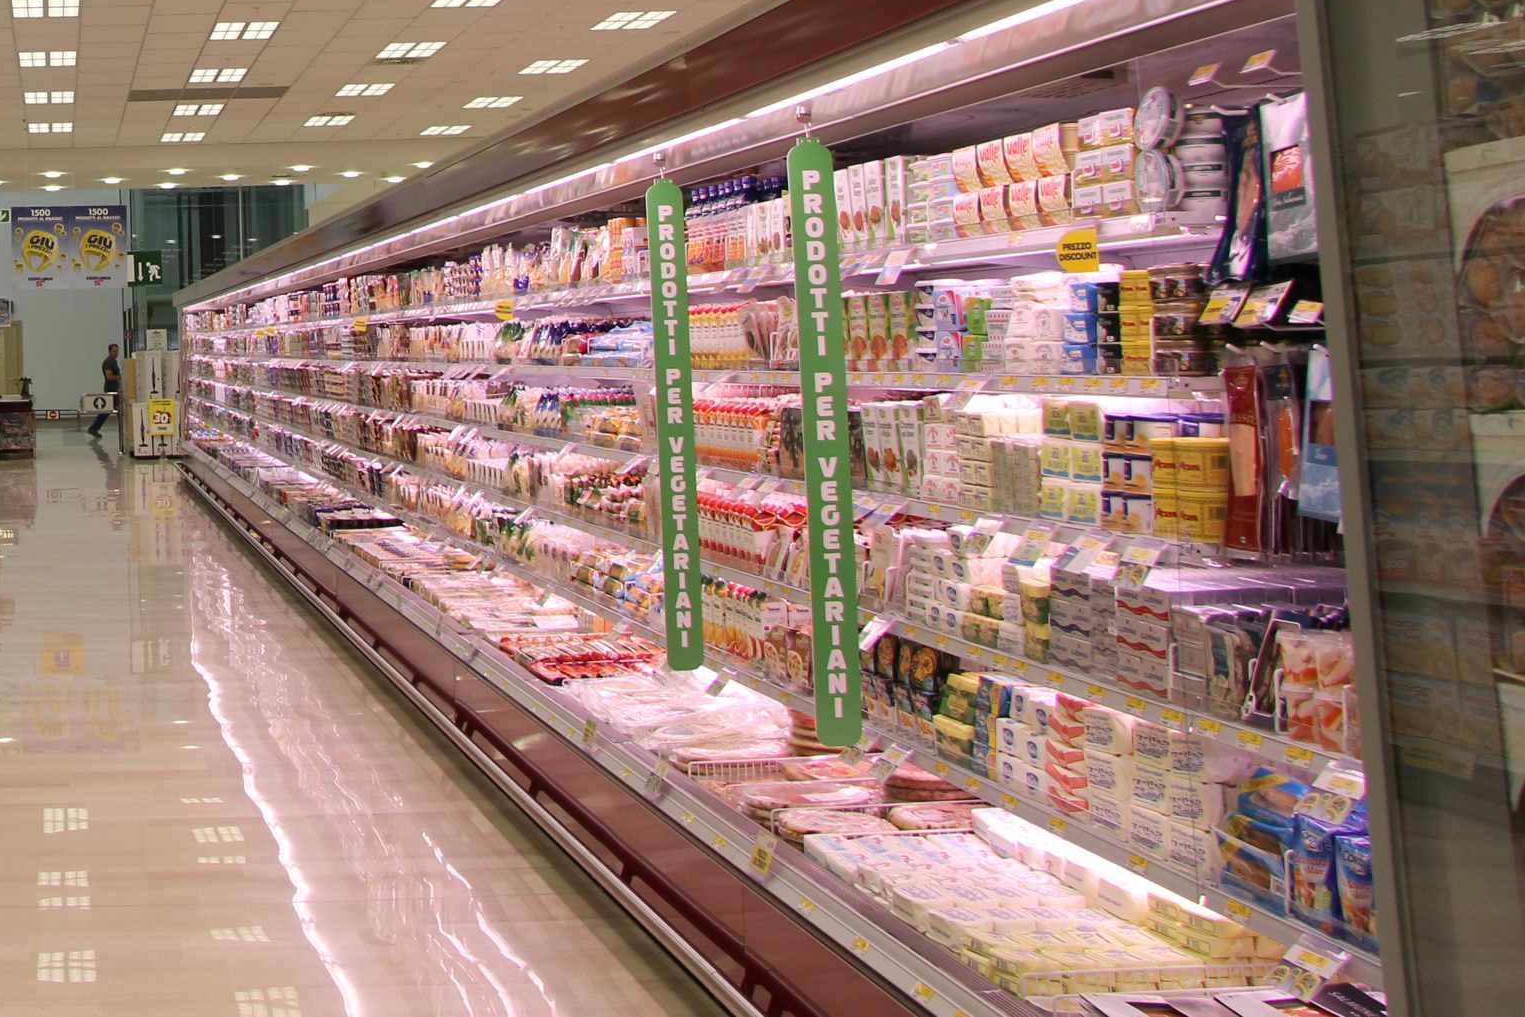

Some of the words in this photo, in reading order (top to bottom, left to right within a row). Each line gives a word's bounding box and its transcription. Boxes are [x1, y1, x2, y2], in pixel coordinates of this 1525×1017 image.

[31, 209, 51, 217] 1500
[89, 208, 109, 216] 1500
[29, 235, 55, 250] GIÙ
[87, 234, 113, 250] GIÙ
[1059, 251, 1097, 262] DISCOUNT
[1062, 242, 1092, 251] PREZZO
[657, 205, 680, 356] PRODOTTI
[802, 169, 829, 357] PRODOTTI
[666, 368, 683, 424] PER
[814, 372, 836, 441] PER
[668, 436, 692, 648] VEGETARIANI
[817, 457, 848, 719] VEGETARIANI
